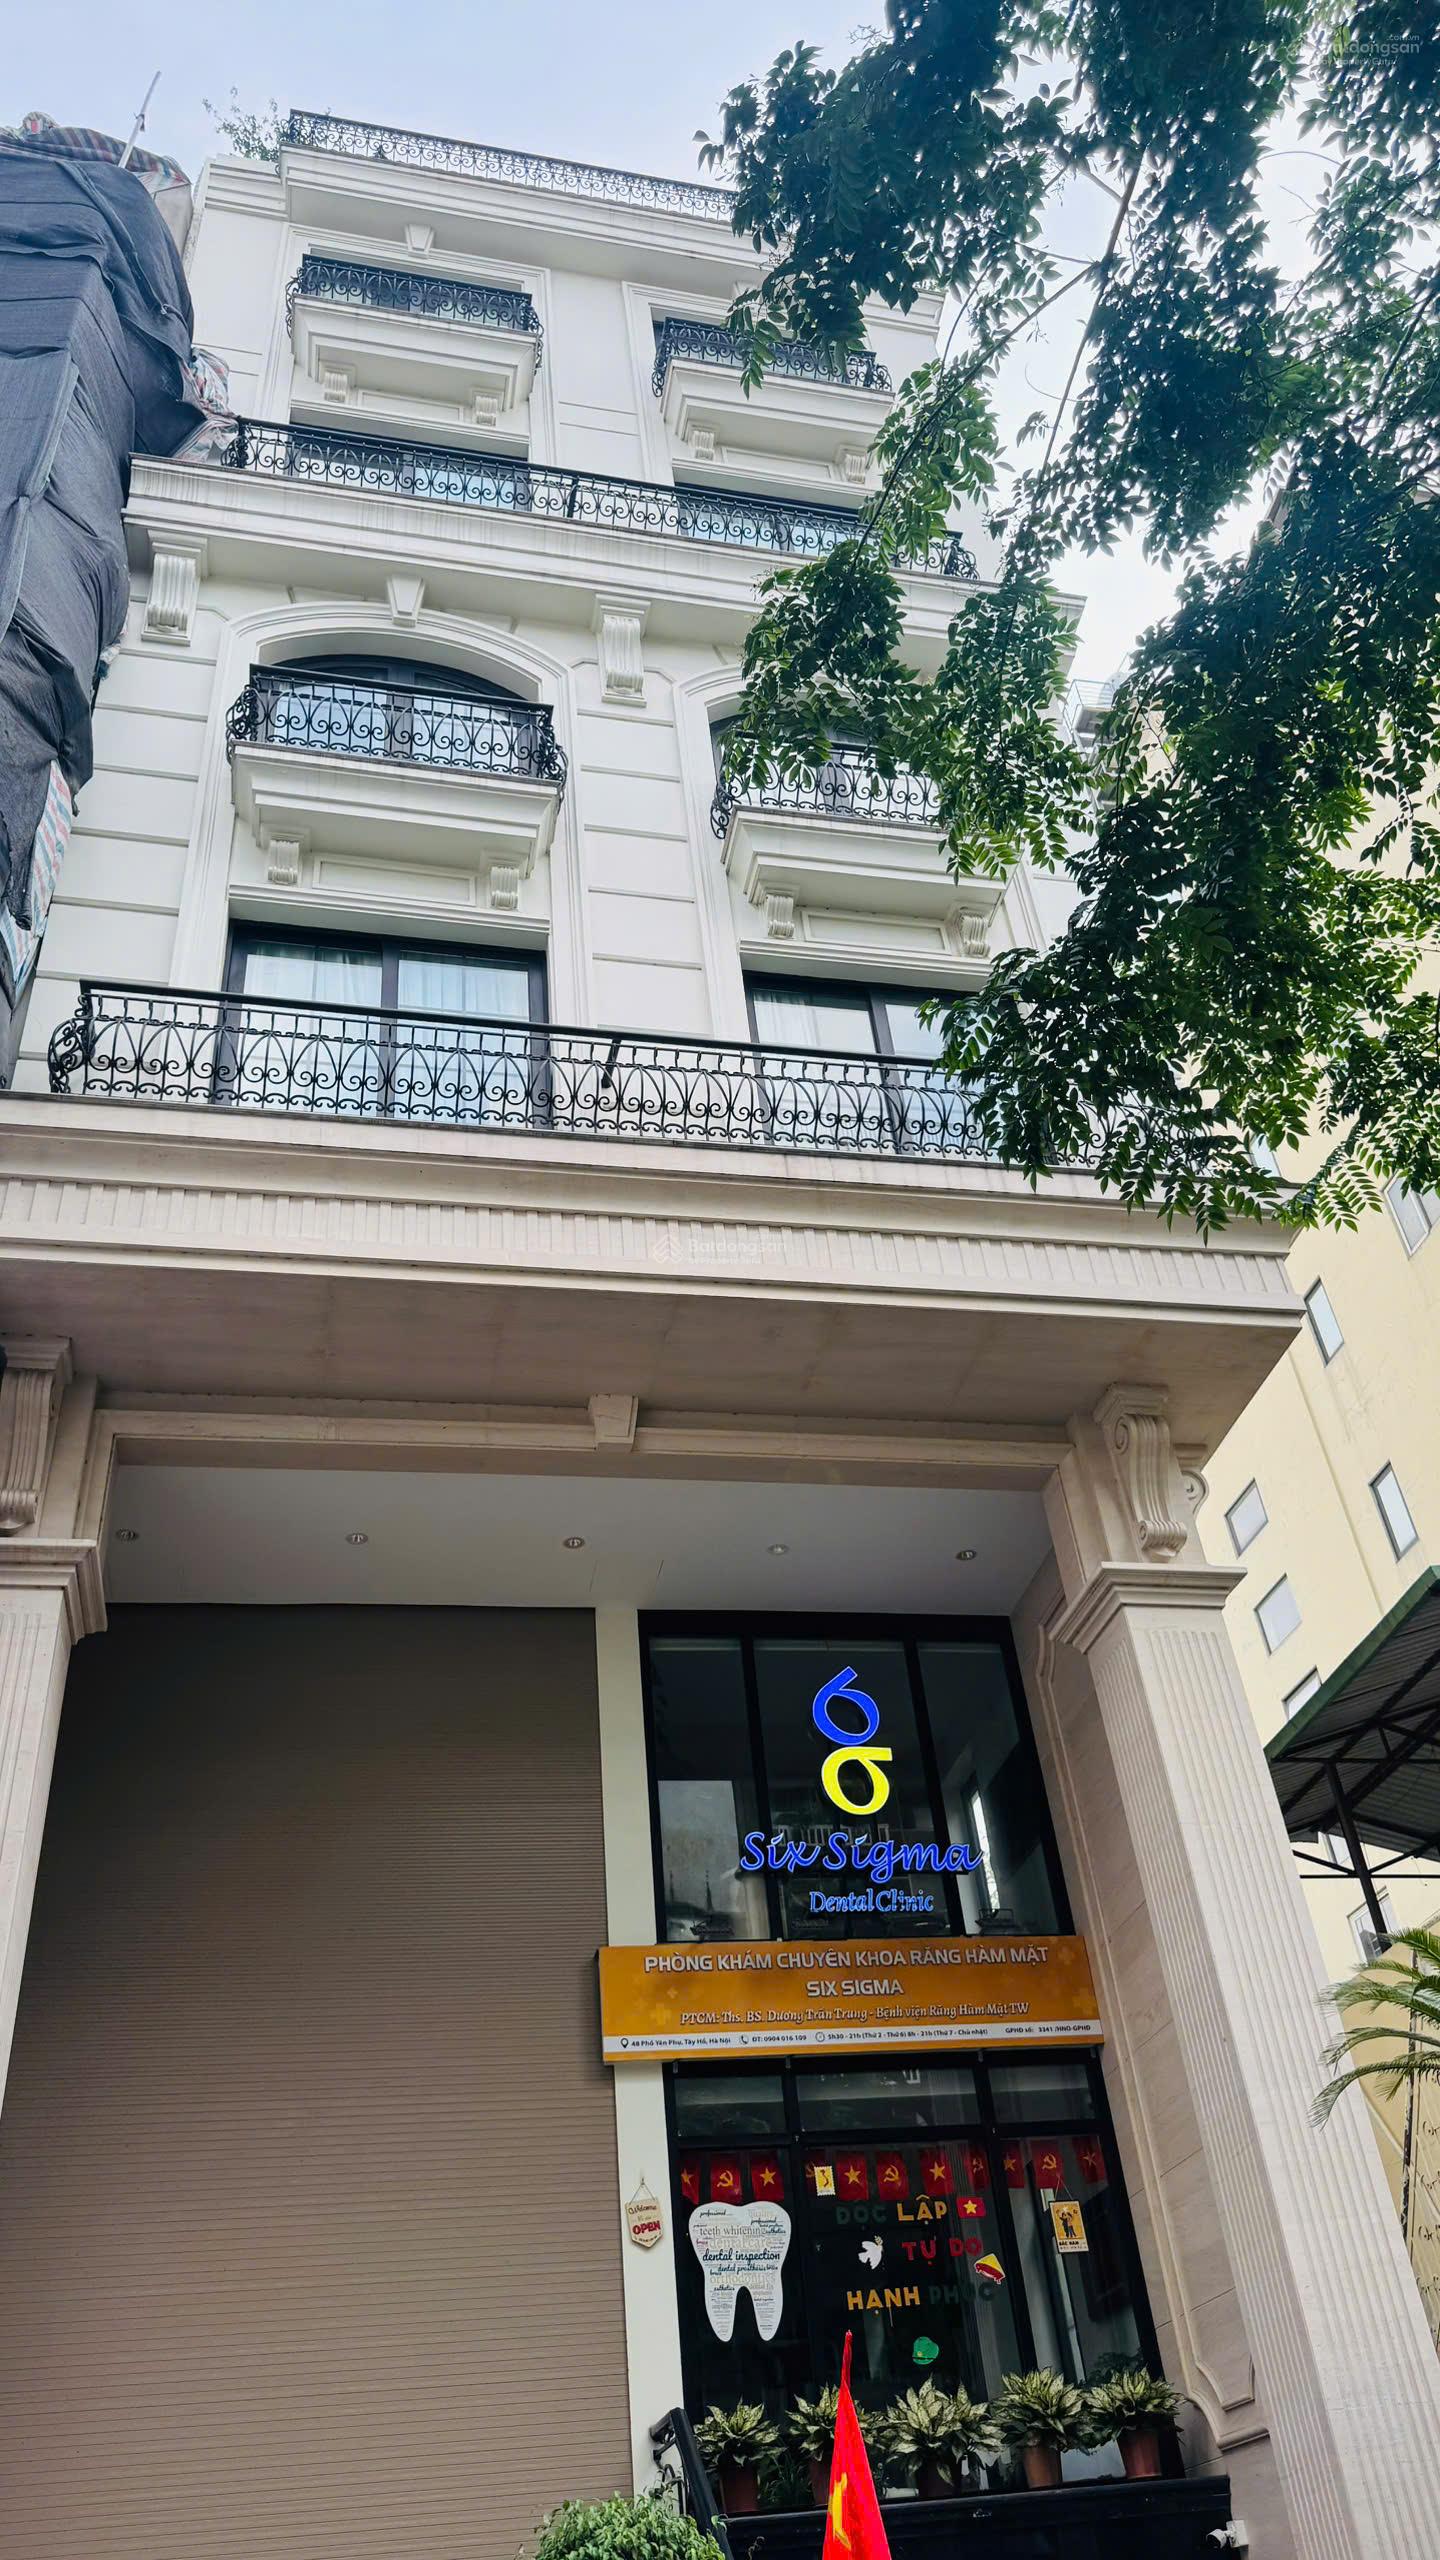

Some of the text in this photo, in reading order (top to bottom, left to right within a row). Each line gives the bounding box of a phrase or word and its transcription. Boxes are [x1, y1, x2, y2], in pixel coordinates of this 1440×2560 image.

[740, 1831, 984, 1884] Six Sigma
[809, 1888, 934, 1913] Dental Clinic
[645, 1944, 1049, 1972] PHÒNG KHÁM CHUYÊN KHOA RĂNG HÀM MẶT
[806, 1978, 904, 1997] SIX SIGMA
[681, 2012, 721, 2025] PTCM:
[834, 2006, 868, 2023] Trung
[875, 2005, 903, 2021] Bệnh
[906, 2004, 927, 2020] viện
[1009, 2001, 1029, 2014] TW
[896, 2194, 948, 2225] LẬP
[632, 2220, 661, 2235] OPEN
[702, 2247, 780, 2266] dental inspection
[949, 2237, 982, 2257] DO
